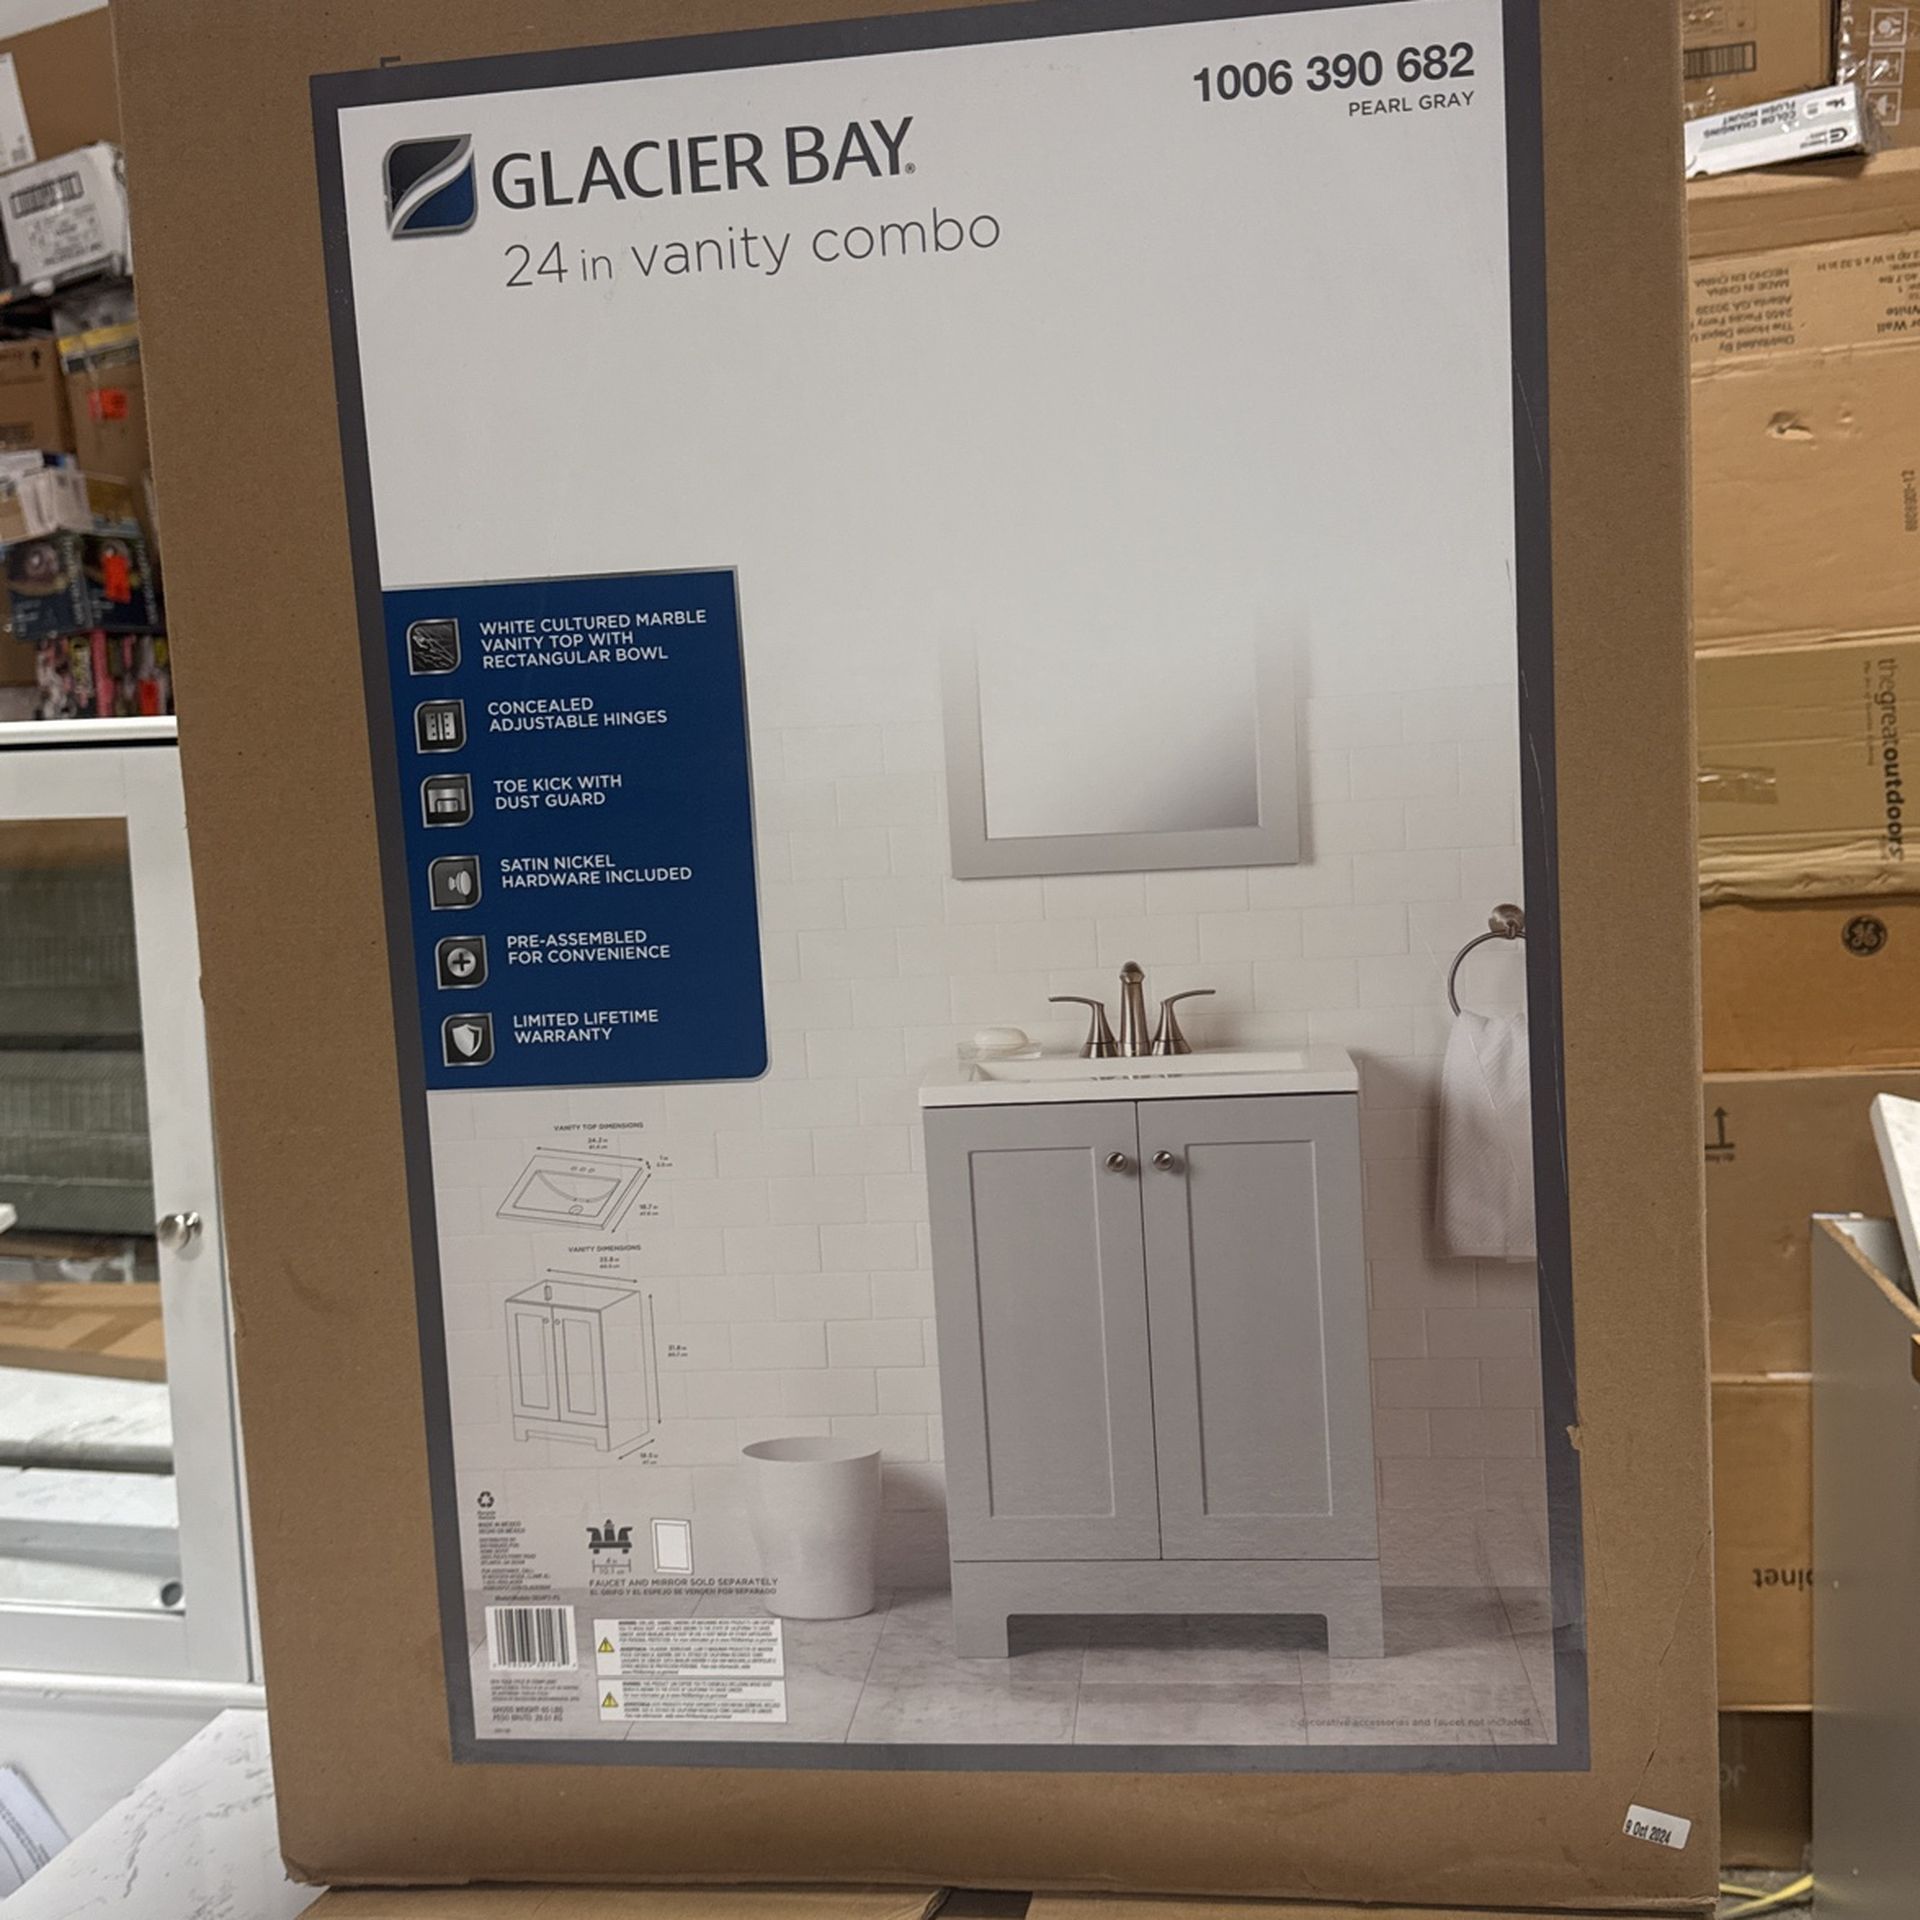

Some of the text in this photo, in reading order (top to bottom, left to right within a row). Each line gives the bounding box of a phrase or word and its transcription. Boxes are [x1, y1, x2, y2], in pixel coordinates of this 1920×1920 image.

[1194, 42, 1475, 101] 1006 390 682
[1349, 91, 1475, 116] PEARL GRAY
[1761, 101, 1796, 114] FLUSH
[1703, 111, 1796, 139] COLOR CHANGING
[1722, 110, 1758, 125] MOUNT
[492, 133, 770, 210] GLACIER
[504, 207, 1001, 288] 24 in vanity combo
[1736, 323, 1769, 336] Home
[1877, 321, 1907, 333] Wall
[480, 609, 707, 636] WHITE CULTURED MARBLE
[481, 631, 634, 653] VANITY TOP WITH
[483, 646, 669, 669] RECTANGULAR BOWL
[488, 697, 594, 717] CONCEALED
[489, 710, 668, 733] ADJUSTABLE HINGES
[493, 774, 622, 794] TOE KICK WITH
[495, 791, 606, 810] DUST GUARD
[500, 854, 616, 873] SATIN NICKEL
[502, 867, 692, 889] HARDWARE INCLUDED
[507, 930, 647, 949] PRE-ASSEMBLED
[508, 945, 671, 965] FOR CONVENIENCE
[513, 1009, 659, 1029] LIMITED LIFETIME
[514, 1027, 612, 1044] WARRANTY
[582, 1123, 597, 1131] TOP
[599, 1122, 644, 1130] DIMENSIONS
[596, 1244, 642, 1252] DIMENSIONS
[589, 1577, 778, 1587] FAUCET AND MIRROR SOLD SEPARATELY
[1299, 1717, 1350, 1727] decorative
[1354, 1717, 1411, 1727] accessories
[1412, 1717, 1430, 1726] and
[1434, 1717, 1464, 1727] faucet
[1468, 1717, 1485, 1726] not
[1633, 1821, 1650, 1838] Oct
[1649, 1826, 1673, 1844] 2024
